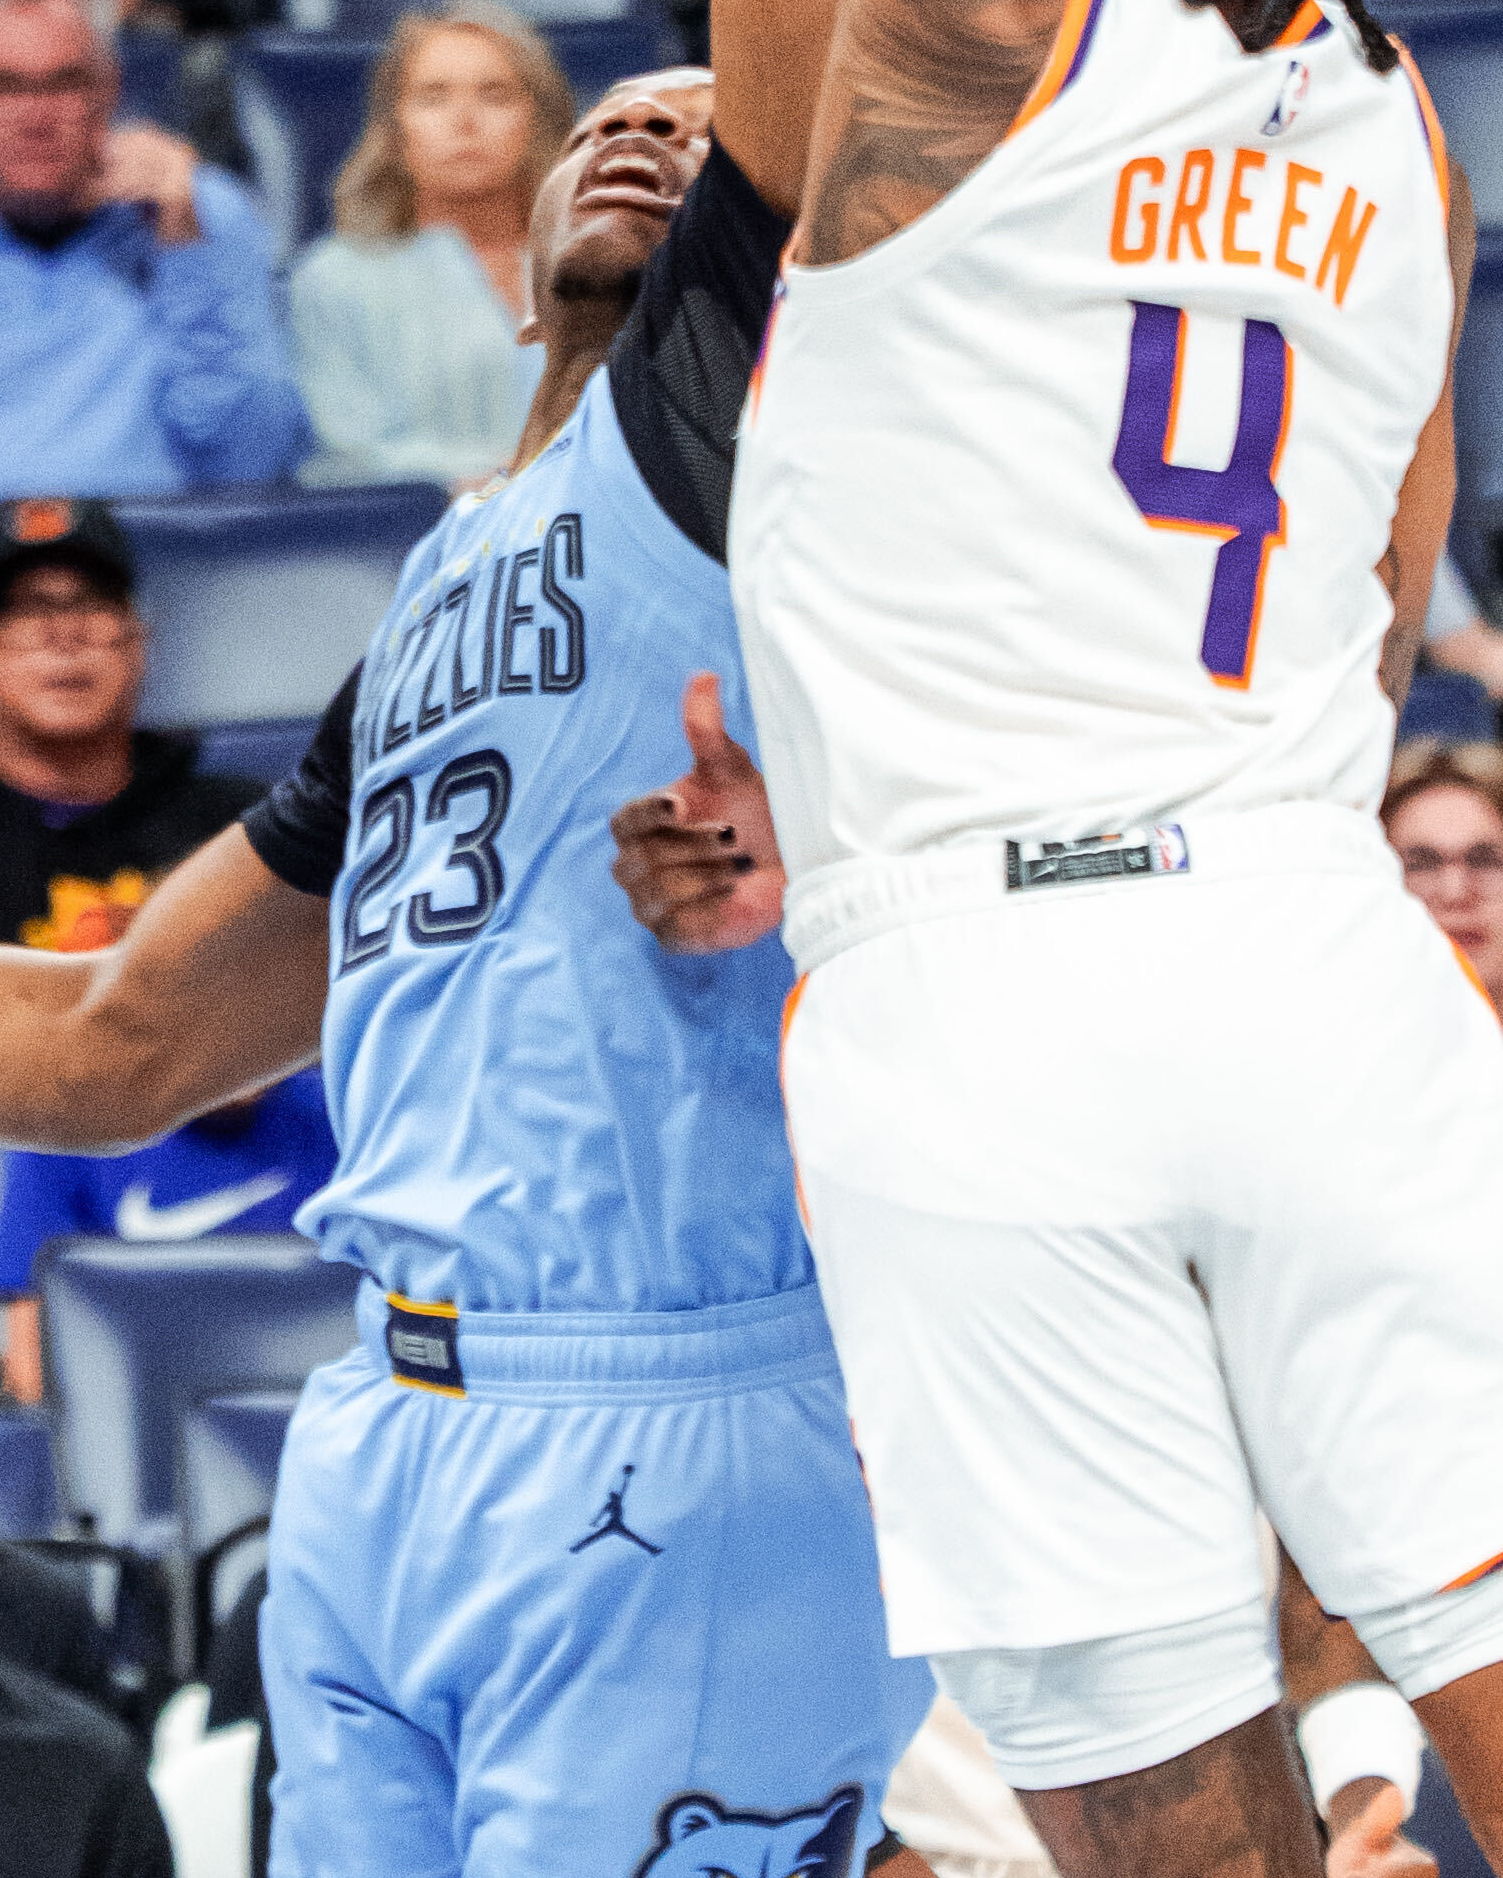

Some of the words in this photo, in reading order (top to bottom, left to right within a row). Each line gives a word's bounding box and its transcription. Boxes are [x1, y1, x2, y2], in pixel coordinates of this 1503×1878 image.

[1110, 148, 1378, 310] GREEN
[1111, 299, 1295, 692] 4
[338, 748, 513, 979] 23
